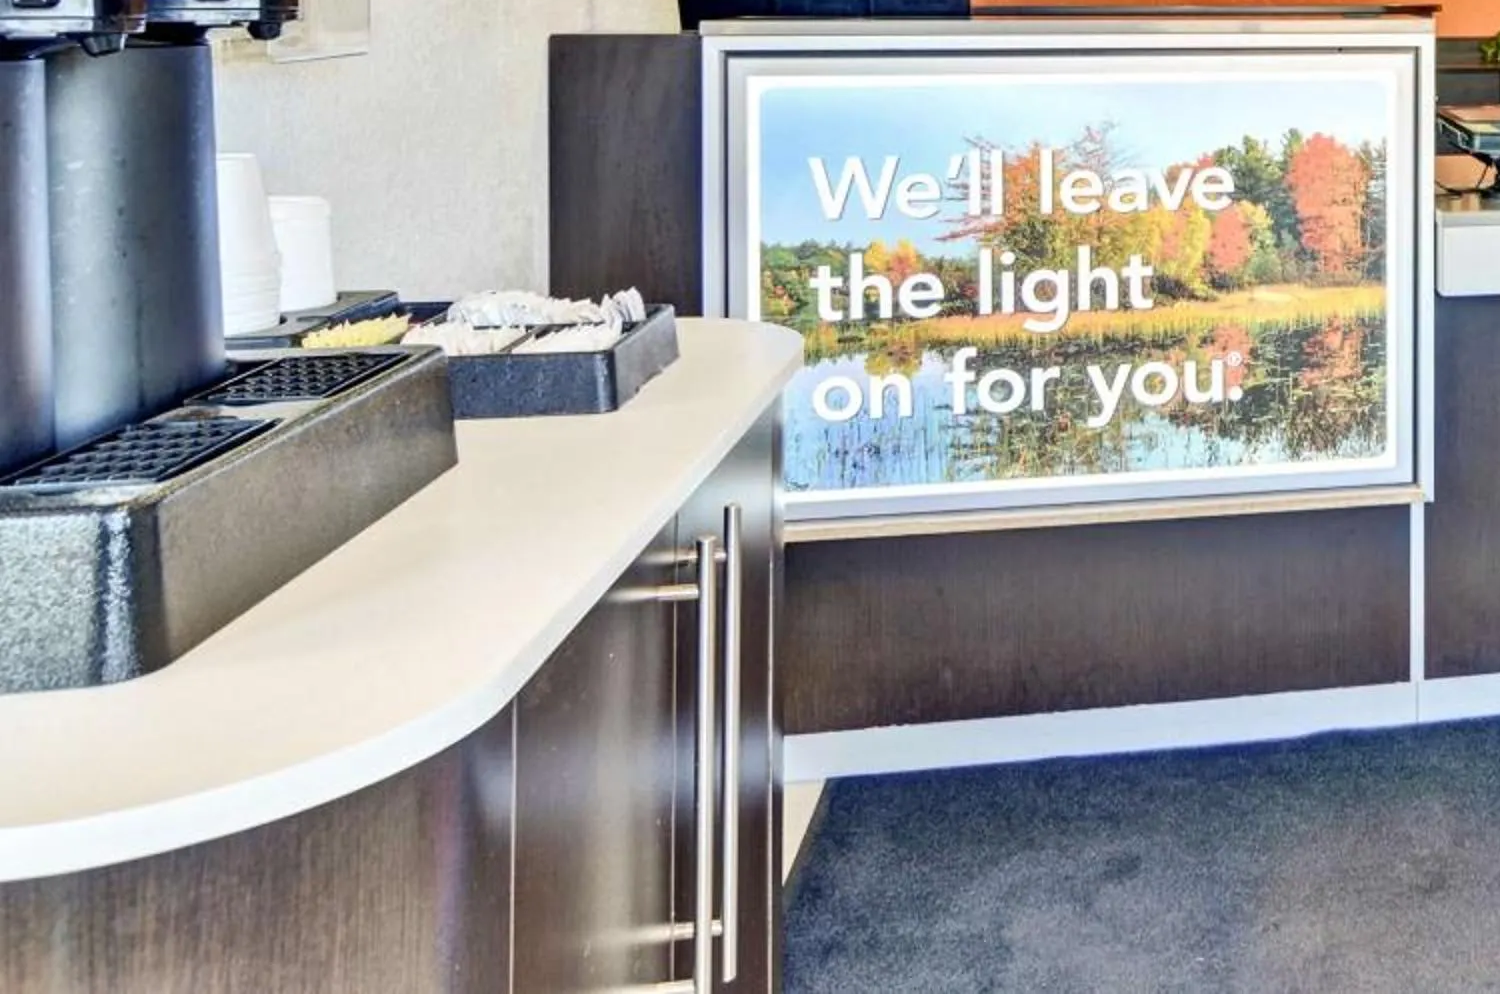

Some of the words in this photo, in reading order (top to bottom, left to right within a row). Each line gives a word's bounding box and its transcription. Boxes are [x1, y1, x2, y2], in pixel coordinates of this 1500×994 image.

[809, 149, 1003, 221] We'll
[1039, 148, 1236, 216] leave
[810, 252, 944, 322] the
[978, 244, 1155, 333] light
[811, 374, 913, 423] on
[944, 346, 1062, 416] for
